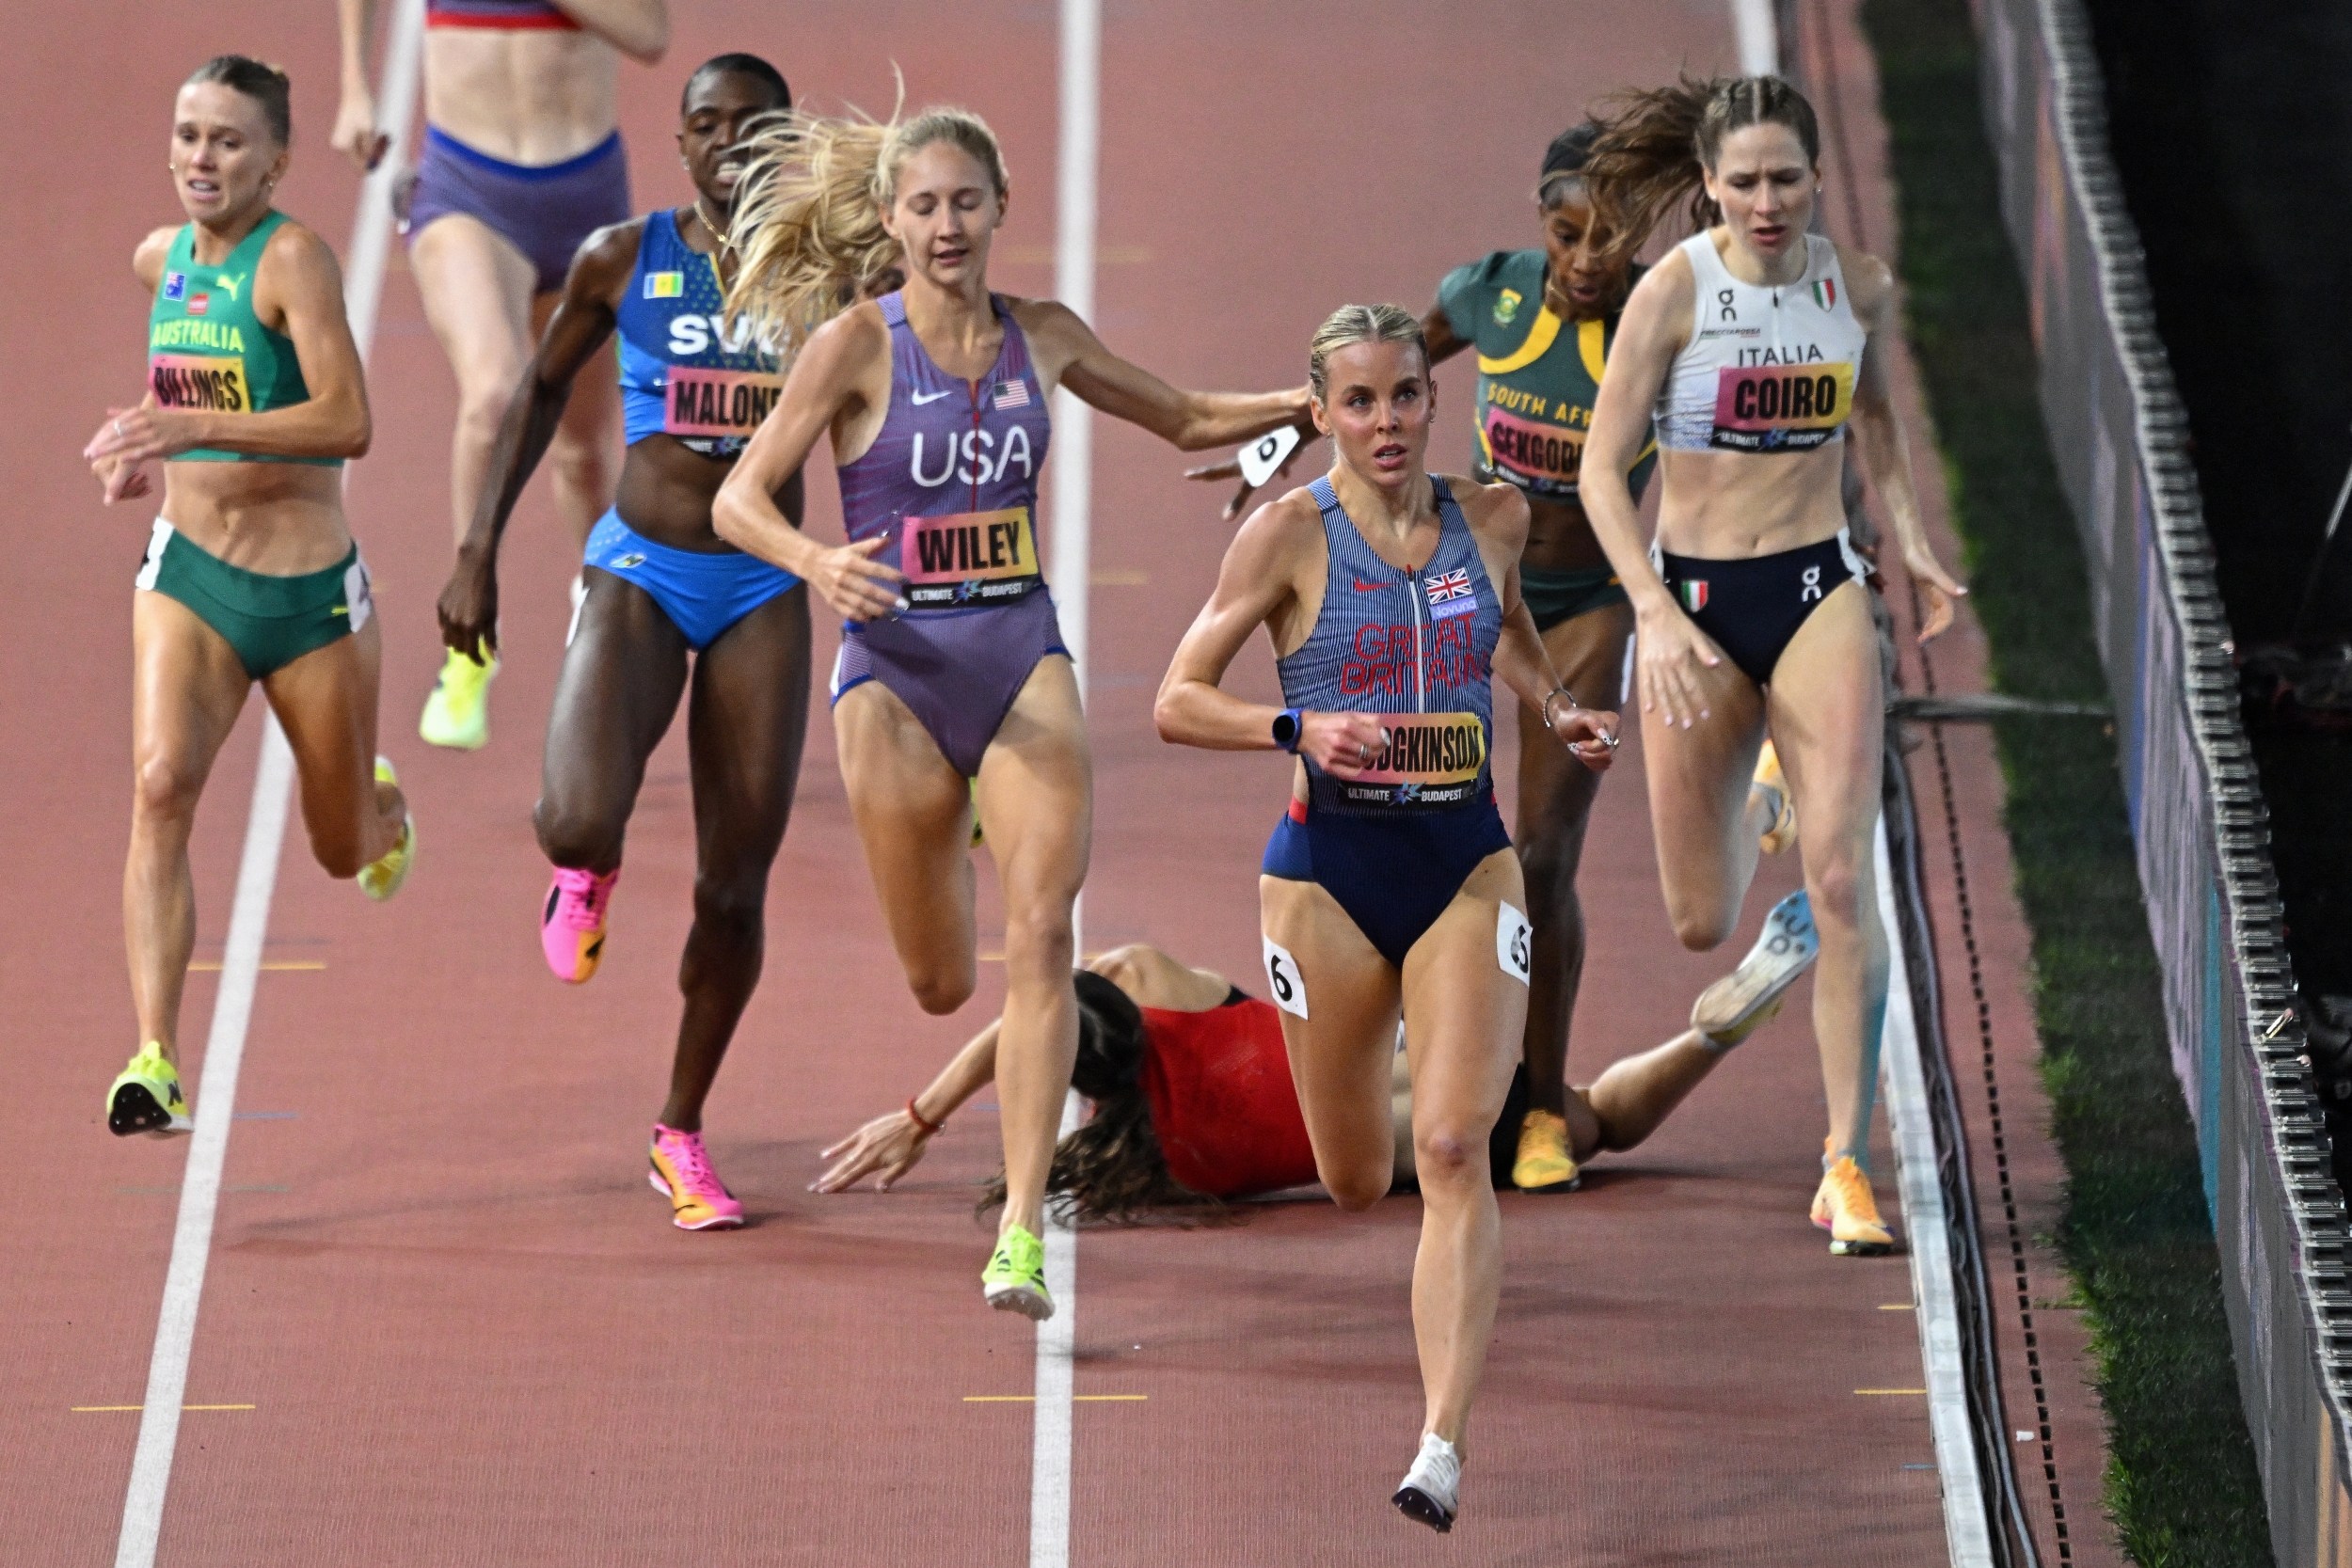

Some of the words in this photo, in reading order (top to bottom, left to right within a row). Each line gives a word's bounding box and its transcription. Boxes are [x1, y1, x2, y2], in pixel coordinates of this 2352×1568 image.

[151, 320, 245, 353] AUSTRALIA
[1739, 343, 1823, 367] ITALIA
[154, 367, 242, 412] BILLINGS
[1487, 382, 1547, 416] SOUTH
[1734, 374, 1837, 420] COIRO
[911, 425, 1032, 487] USA
[917, 521, 1021, 574] WILEY
[911, 587, 954, 602] ULTIMATE
[981, 582, 1023, 597] BUDAPEST
[1354, 612, 1476, 660] GREAT
[1341, 650, 1488, 695] BRITAIN
[1364, 725, 1481, 772] DGKINSON
[1347, 787, 1390, 801] ULTIMATE
[1421, 788, 1462, 802] BUDAPEST
[1510, 925, 1529, 974] 6
[1271, 955, 1293, 1002] 6
